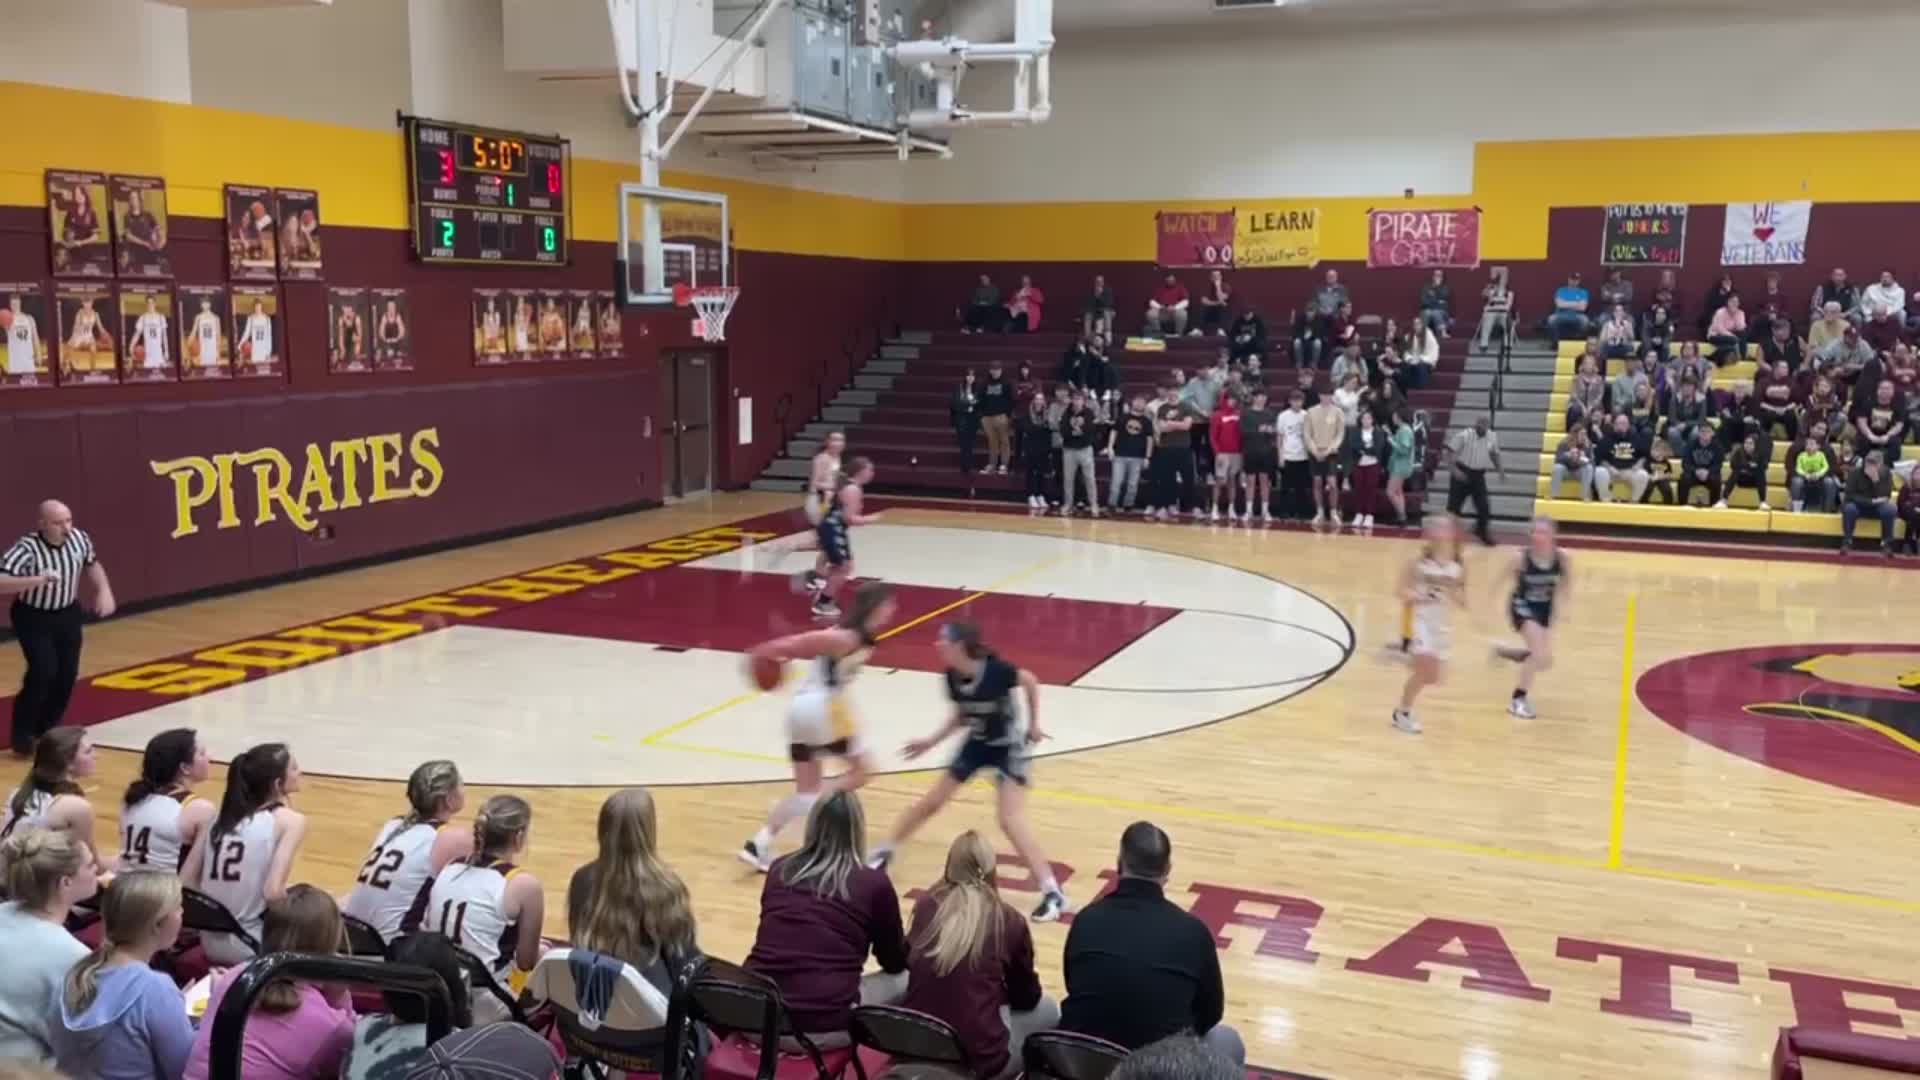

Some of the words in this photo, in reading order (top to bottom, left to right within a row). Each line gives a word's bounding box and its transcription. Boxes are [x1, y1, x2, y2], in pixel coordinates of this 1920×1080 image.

[438, 150, 455, 185] 3
[473, 136, 523, 171] 5:07
[547, 163, 560, 193] 0
[1250, 211, 1315, 233] LEARN
[1375, 212, 1457, 242] PIRATE
[1753, 202, 1782, 226] WE
[442, 221, 454, 247] 2
[544, 227, 555, 251] 0
[150, 427, 443, 539] PIRATES
[91, 526, 777, 695] SOUTHEAST
[121, 822, 152, 864] 14
[208, 838, 245, 882] 12
[357, 845, 405, 891] 22
[440, 898, 468, 946] 11
[903, 853, 1919, 1042] PRATE
